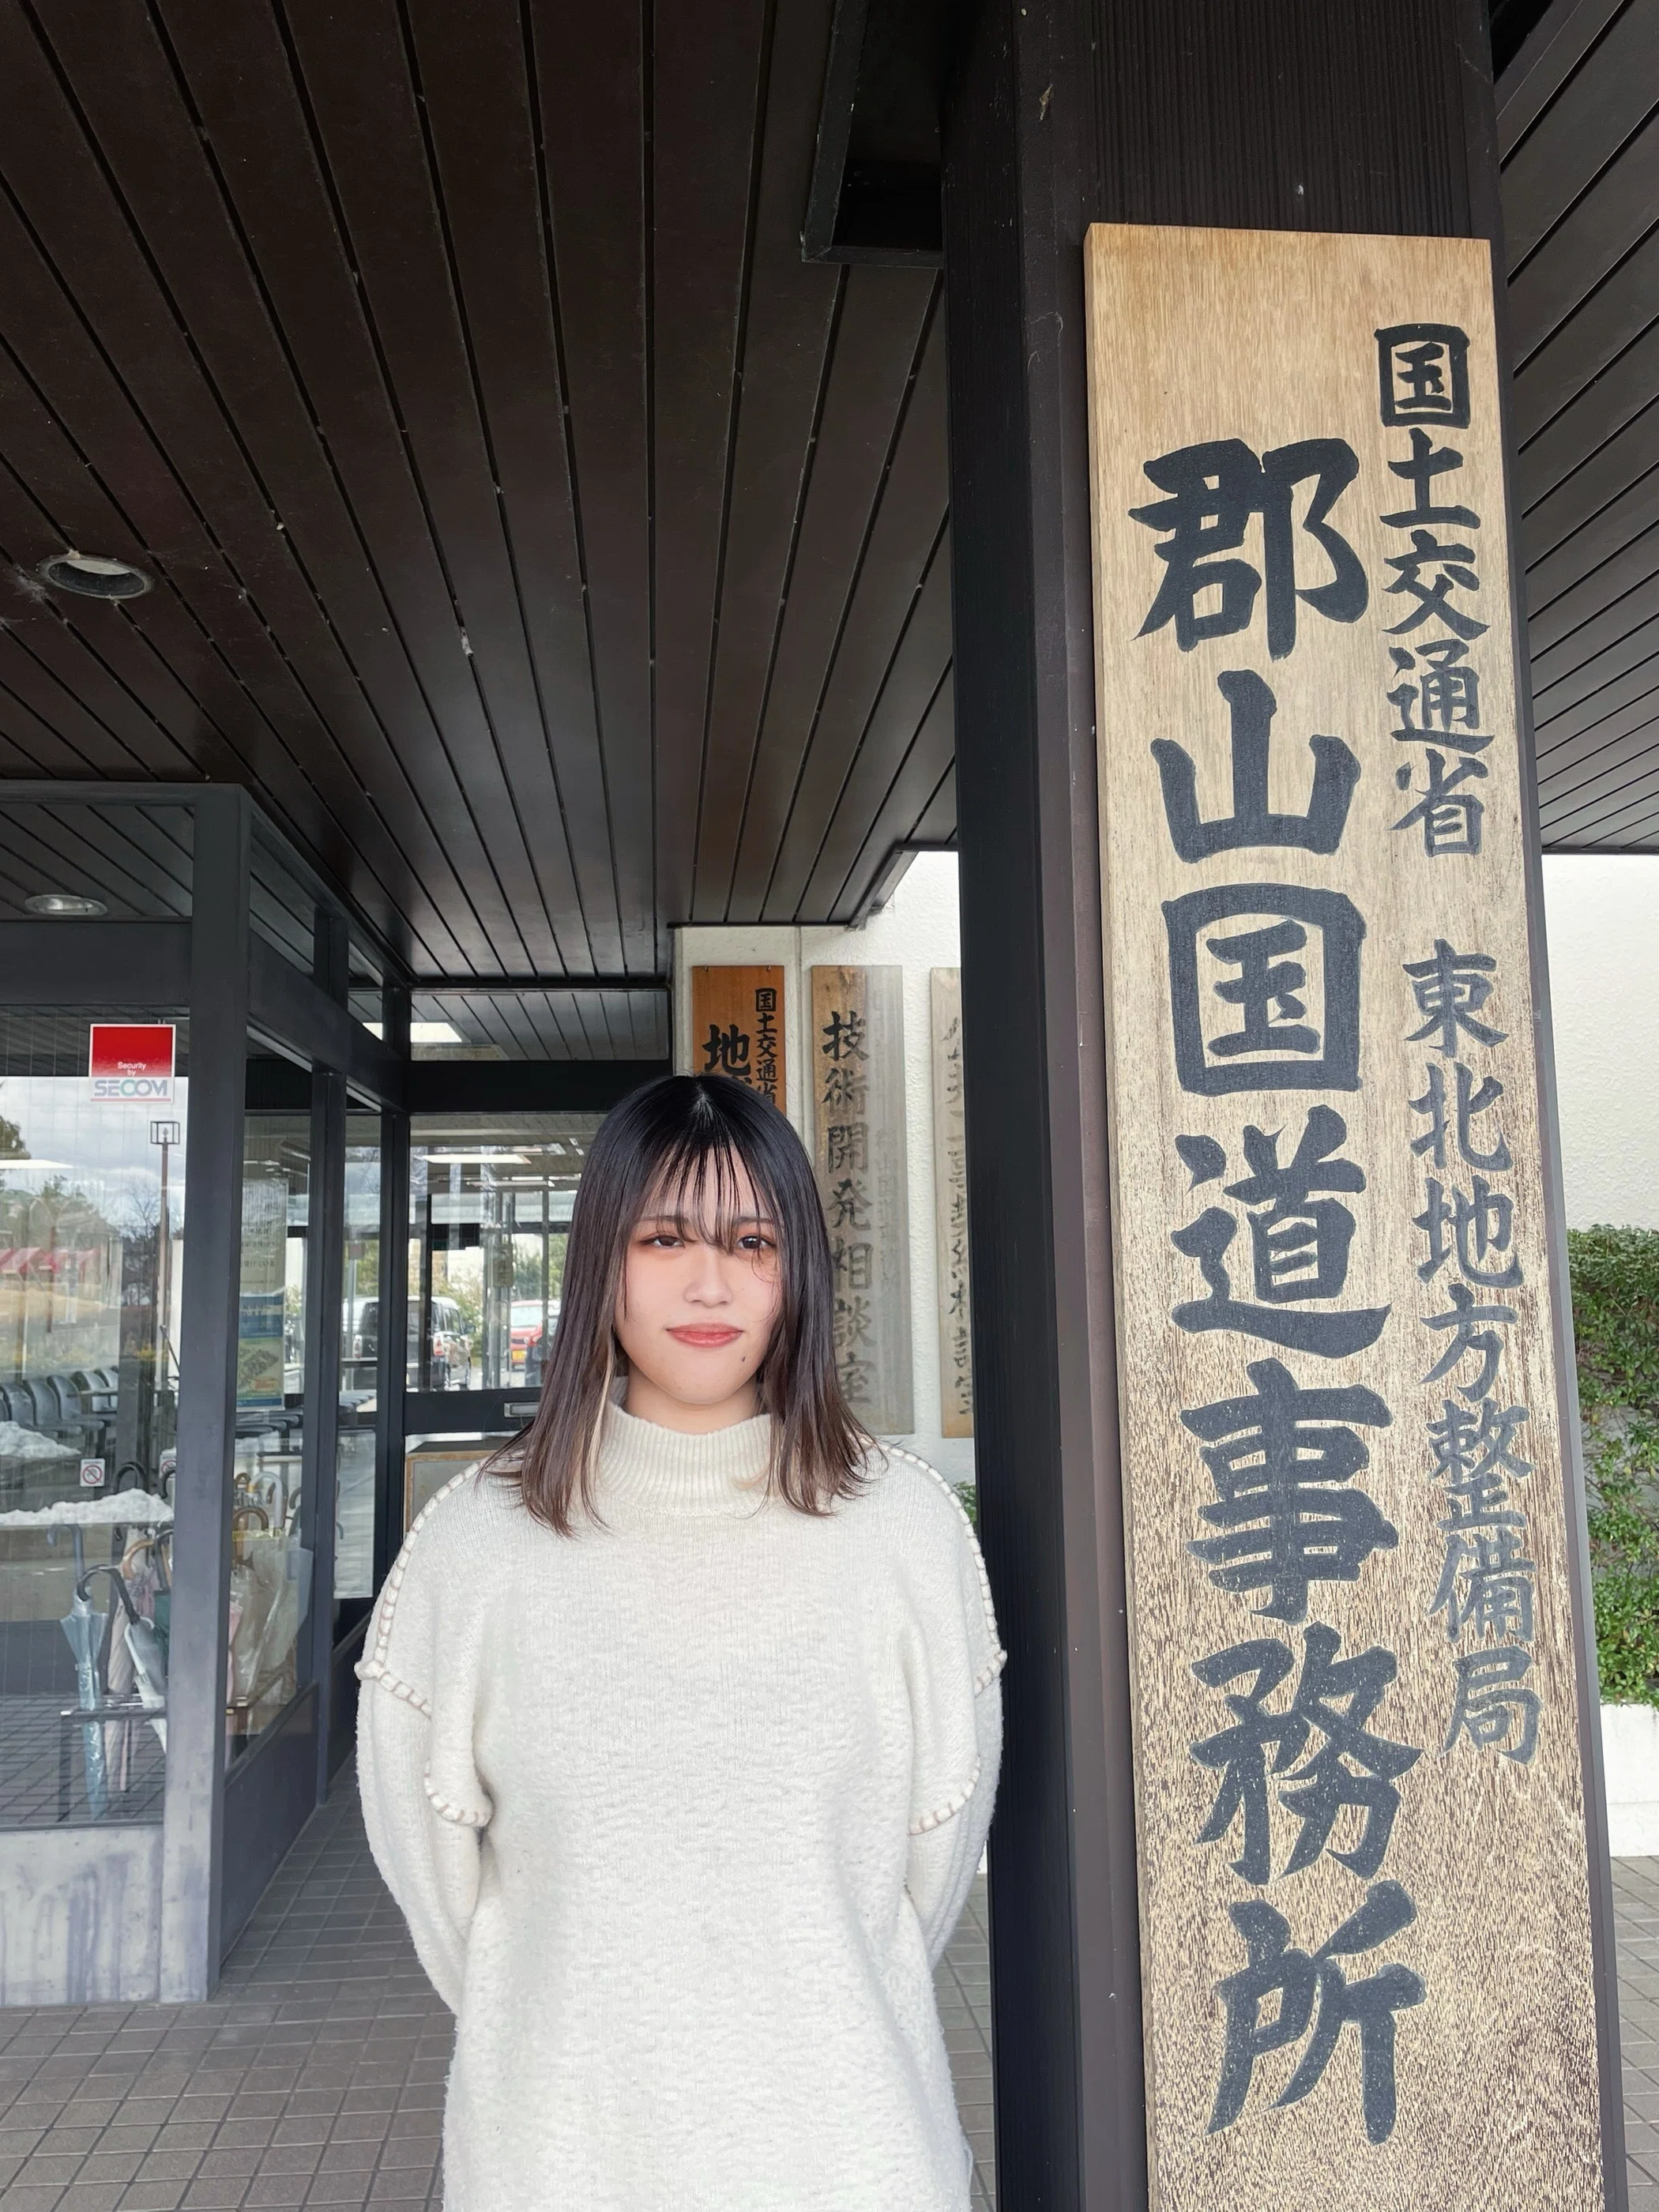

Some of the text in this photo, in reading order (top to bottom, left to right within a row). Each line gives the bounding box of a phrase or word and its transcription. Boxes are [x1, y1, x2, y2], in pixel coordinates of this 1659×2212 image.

[94, 1078, 168, 1097] SECOM
[117, 1062, 147, 1071] Security
[821, 1010, 878, 1403] 技術開発相談室
[1375, 323, 1543, 1766] 国土交通省 東北地方整備局
[1128, 438, 1428, 2146] 郡山国道事務所
